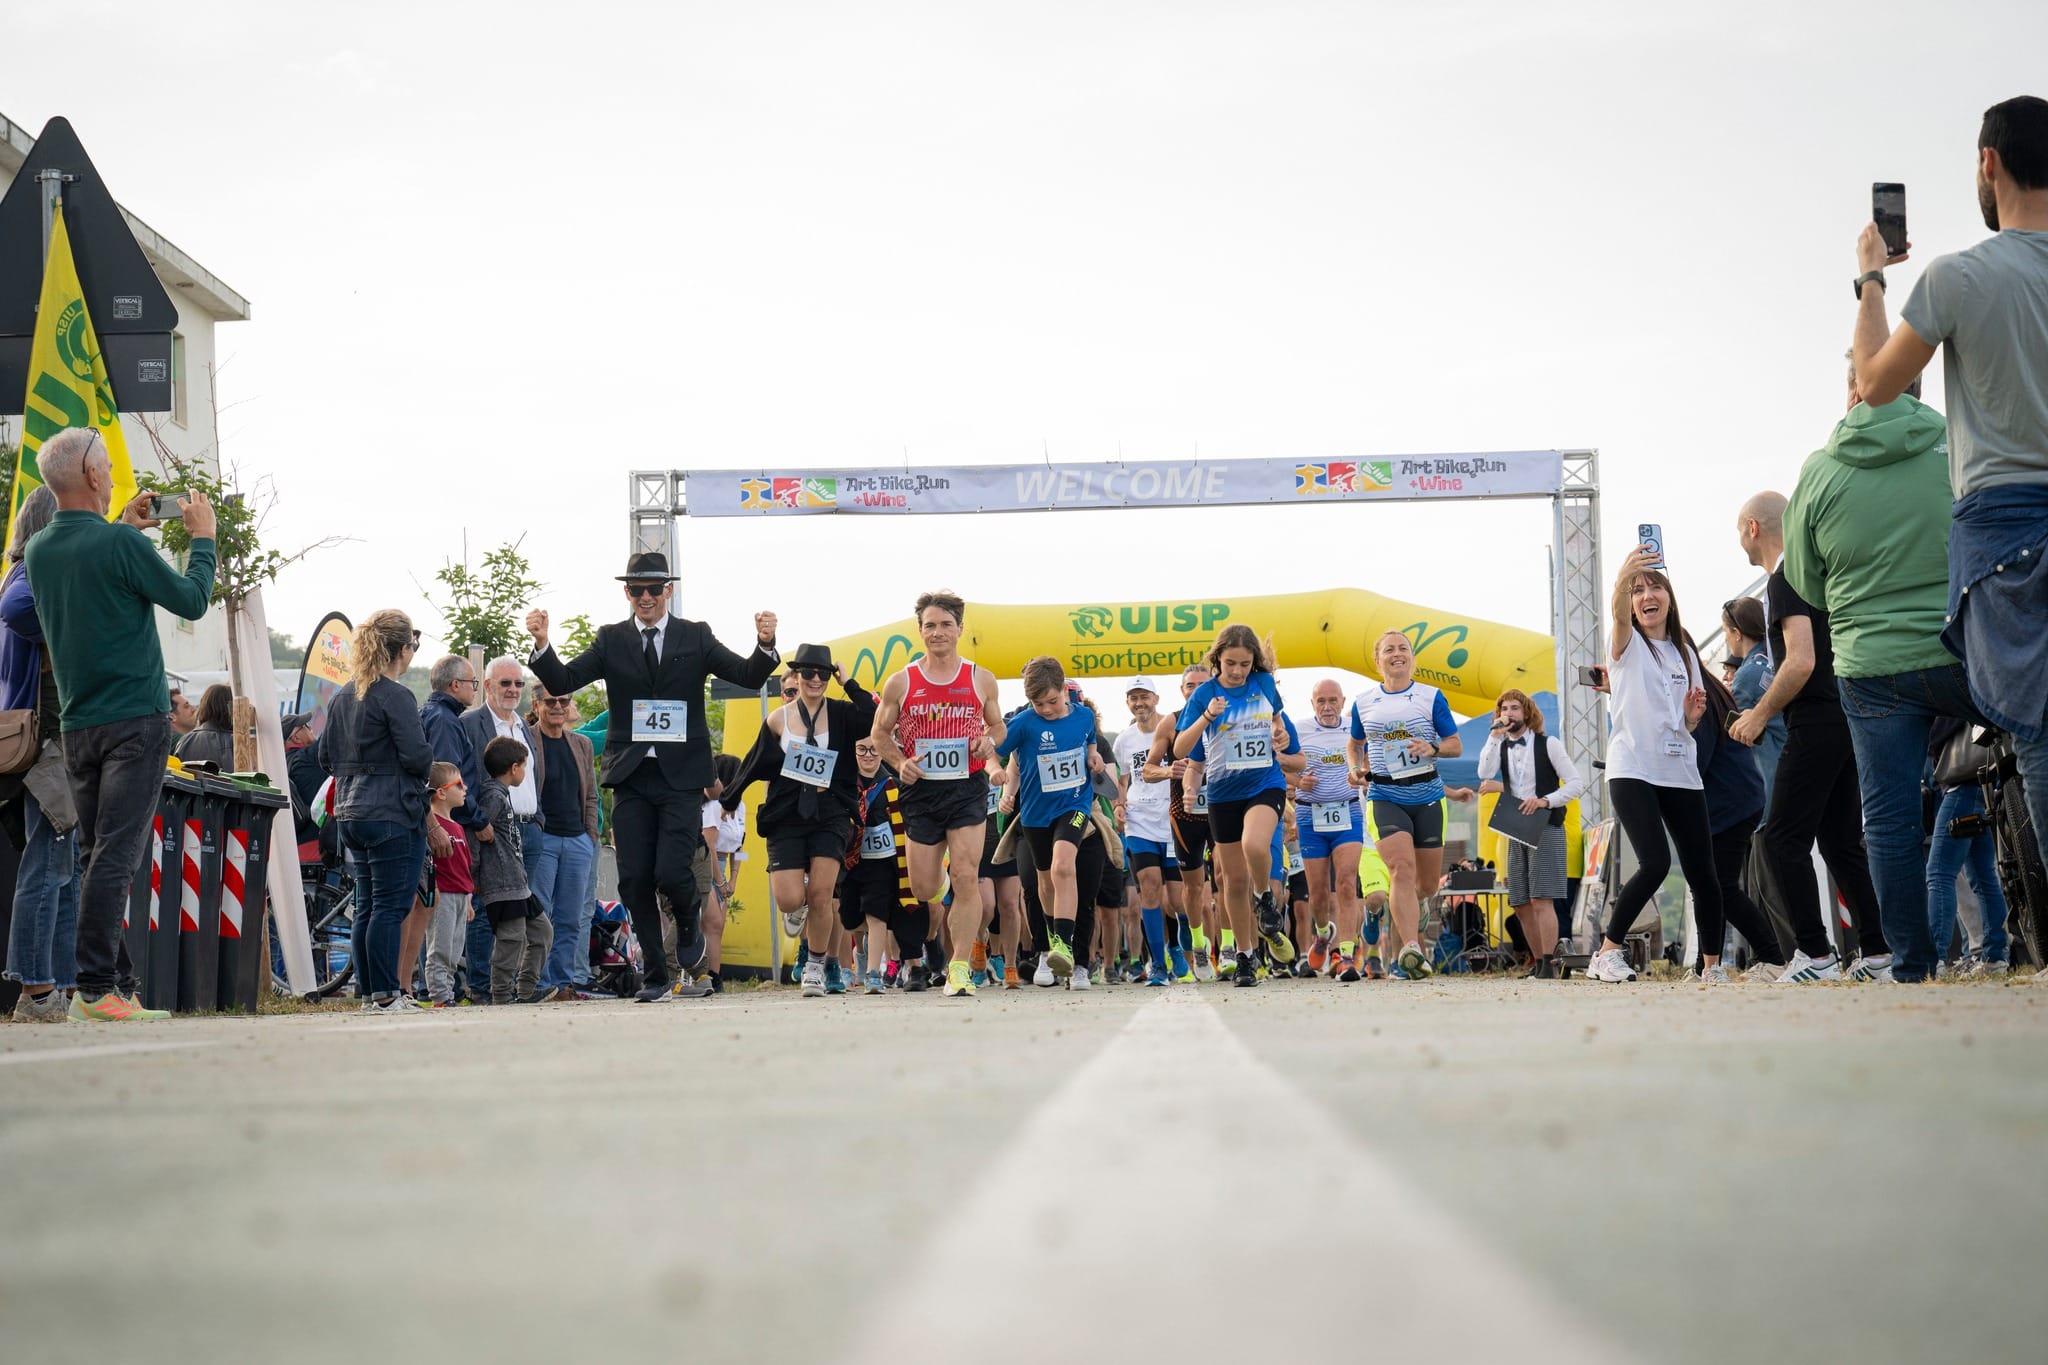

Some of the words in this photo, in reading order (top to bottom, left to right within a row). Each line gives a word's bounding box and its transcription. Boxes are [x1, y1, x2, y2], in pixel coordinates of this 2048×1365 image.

[1401, 459, 1432, 475] Art
[846, 477, 877, 491] Art
[1015, 466, 1228, 504] WELCOME
[1119, 603, 1230, 635] UISP
[1071, 646, 1211, 674] sportpertu
[909, 702, 976, 719] RUNTIME
[645, 712, 671, 730] 45
[1234, 740, 1266, 759] 152
[794, 753, 826, 775] 103
[924, 750, 960, 769] 100
[1047, 760, 1079, 780] 151
[1323, 810, 1340, 823] 16
[865, 834, 891, 850] 150
